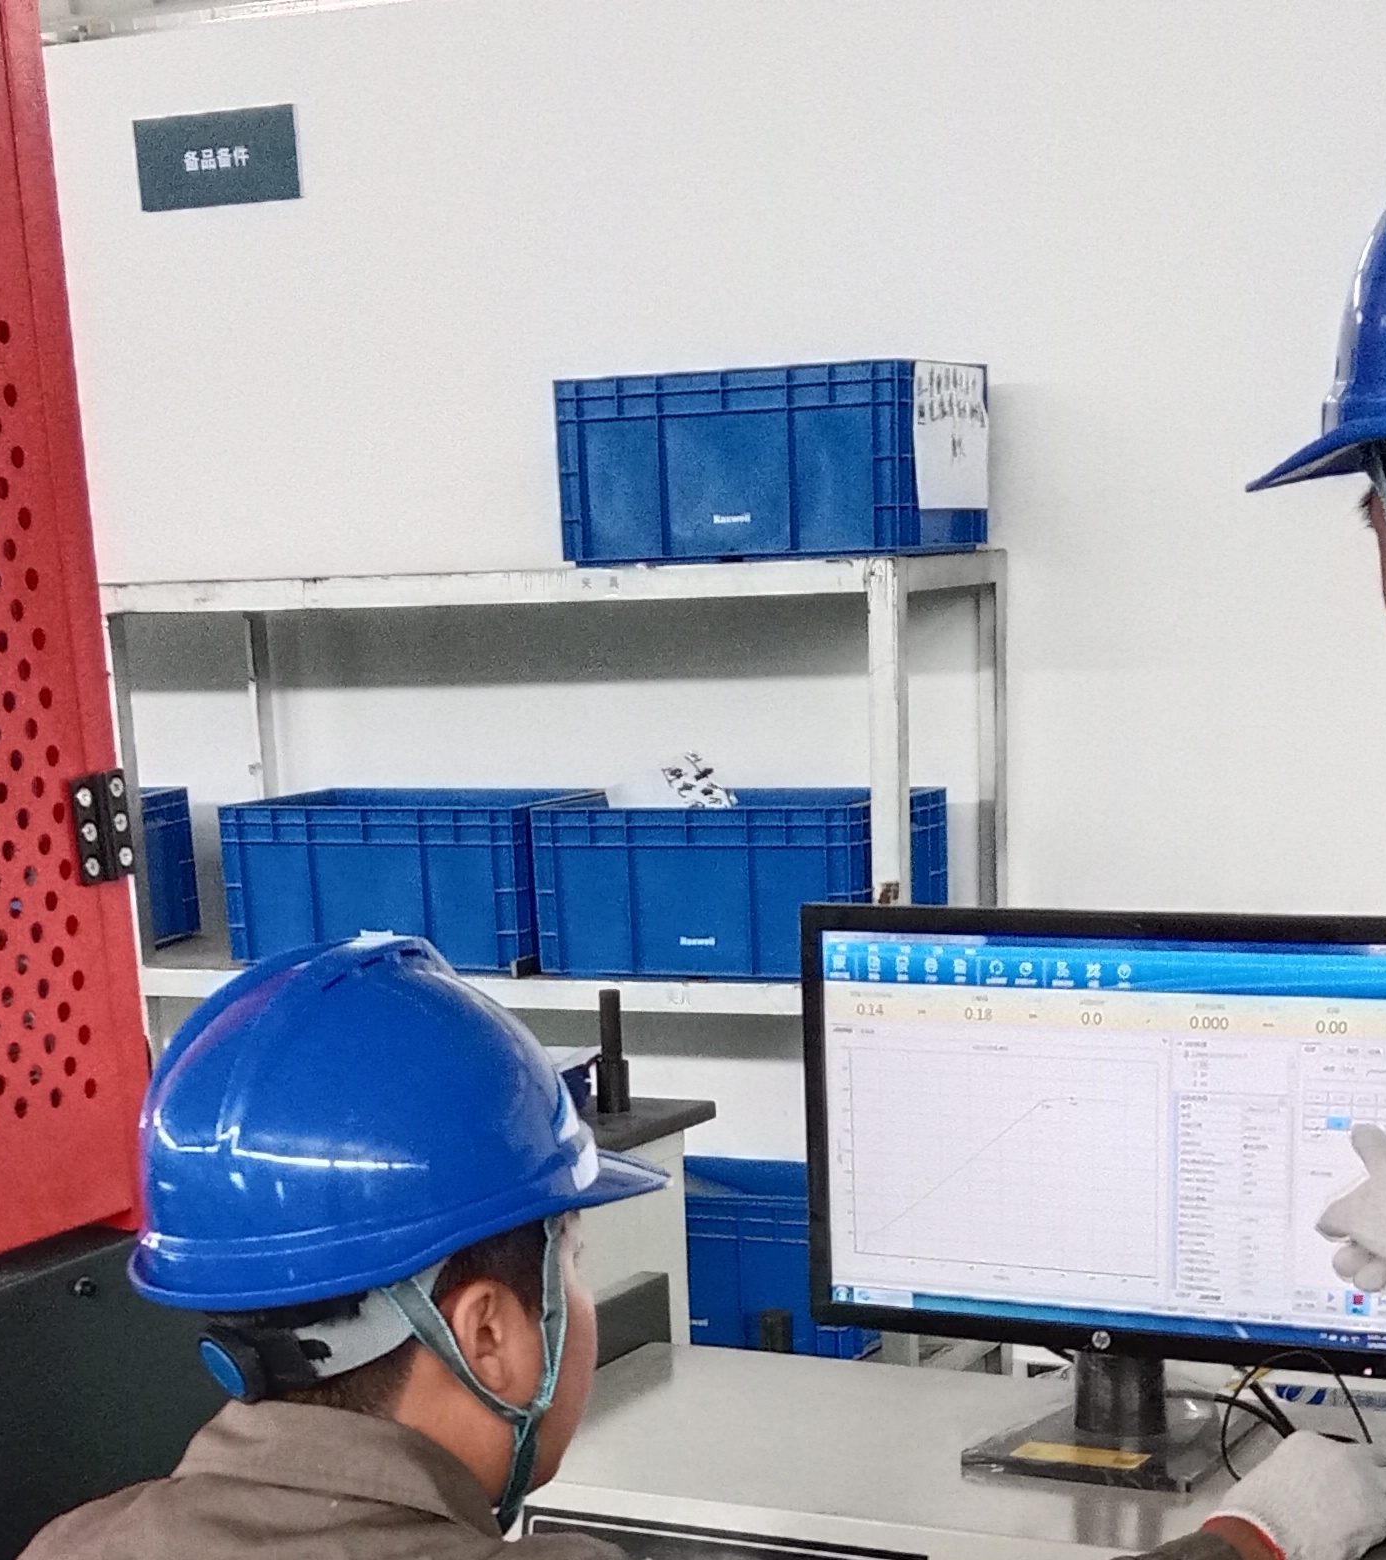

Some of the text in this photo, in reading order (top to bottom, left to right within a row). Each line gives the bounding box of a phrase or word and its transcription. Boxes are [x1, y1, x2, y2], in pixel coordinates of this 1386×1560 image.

[184, 145, 249, 171] 备品备件
[1190, 1015, 1229, 1030] 0.000
[1316, 1020, 1348, 1035] 0.00
